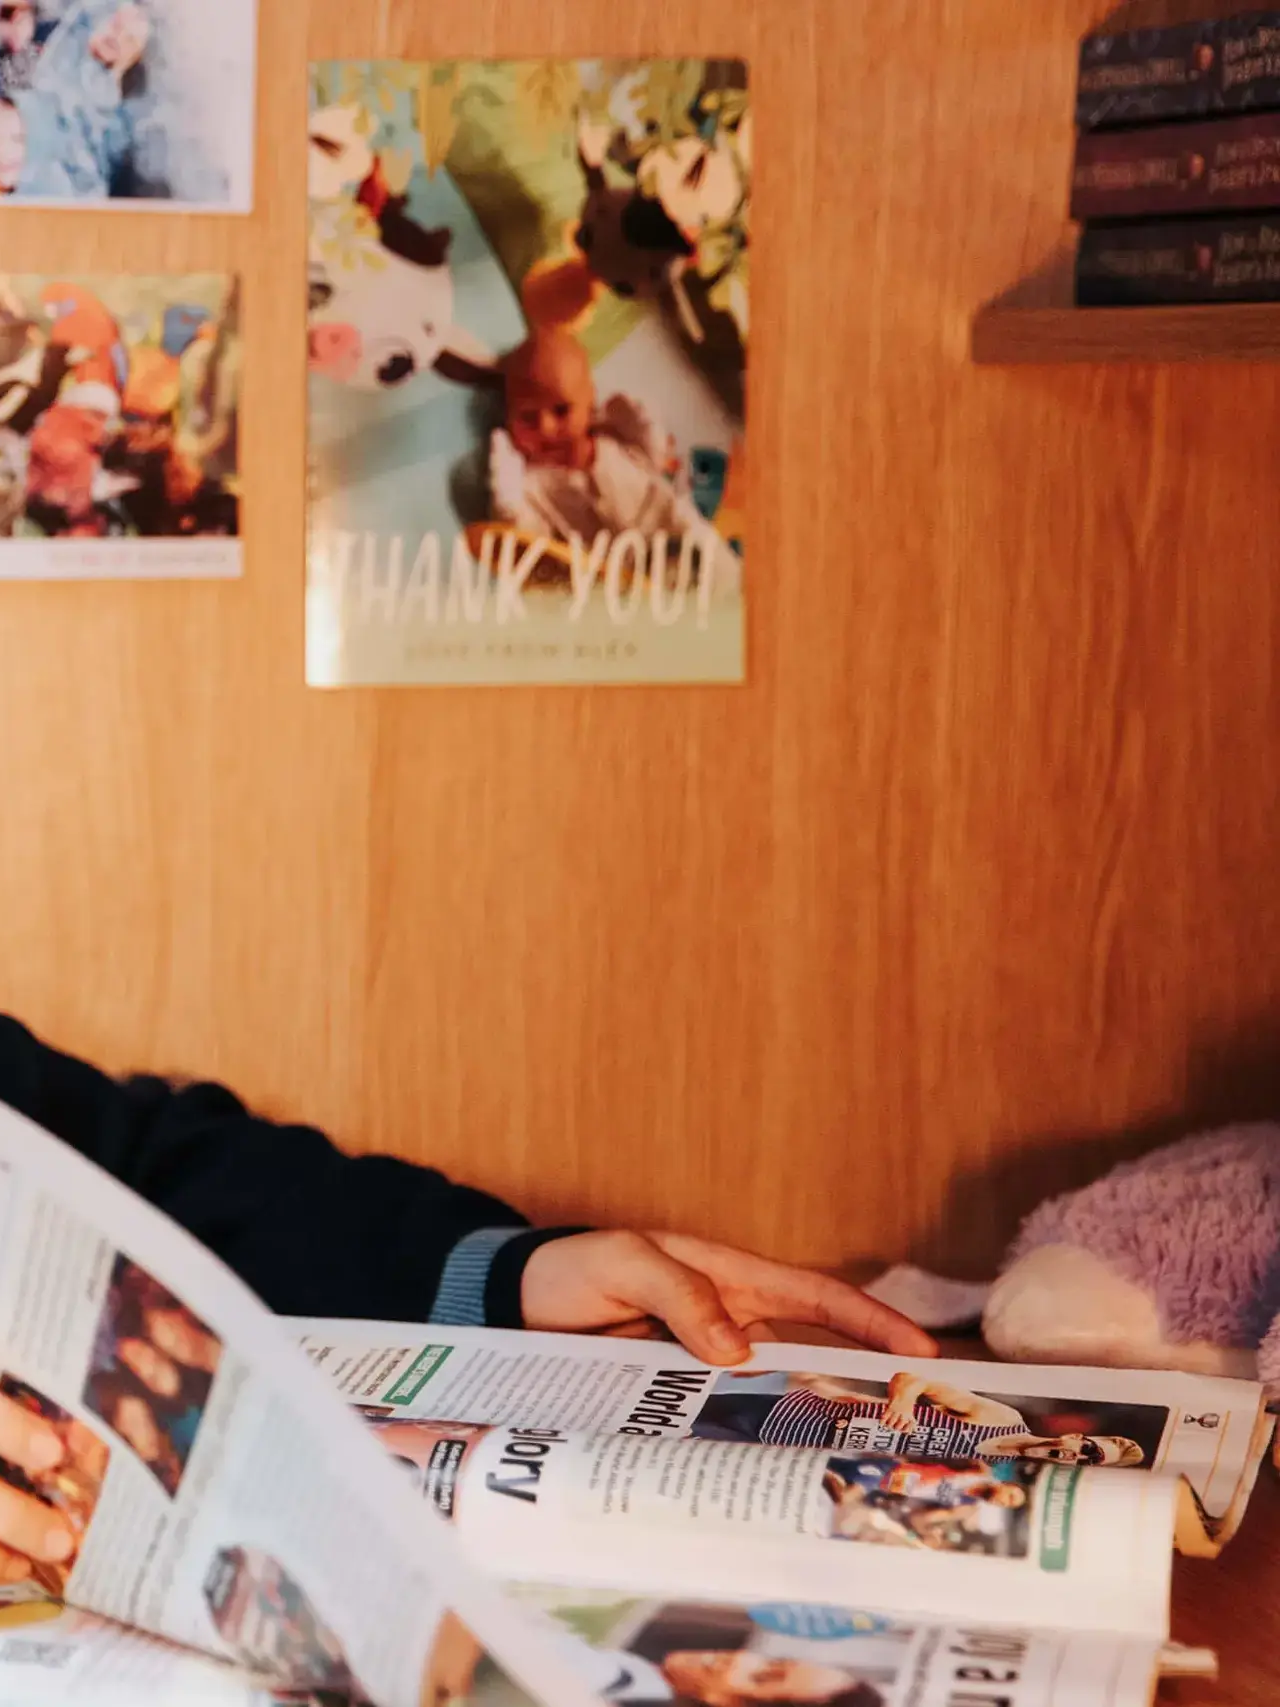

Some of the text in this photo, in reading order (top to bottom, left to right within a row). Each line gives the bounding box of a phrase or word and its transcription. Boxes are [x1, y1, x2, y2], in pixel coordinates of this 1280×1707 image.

[326, 529, 550, 628] THANK
[625, 1369, 712, 1429] World
[485, 1426, 568, 1503] glory
[846, 1426, 871, 1450] KERR
